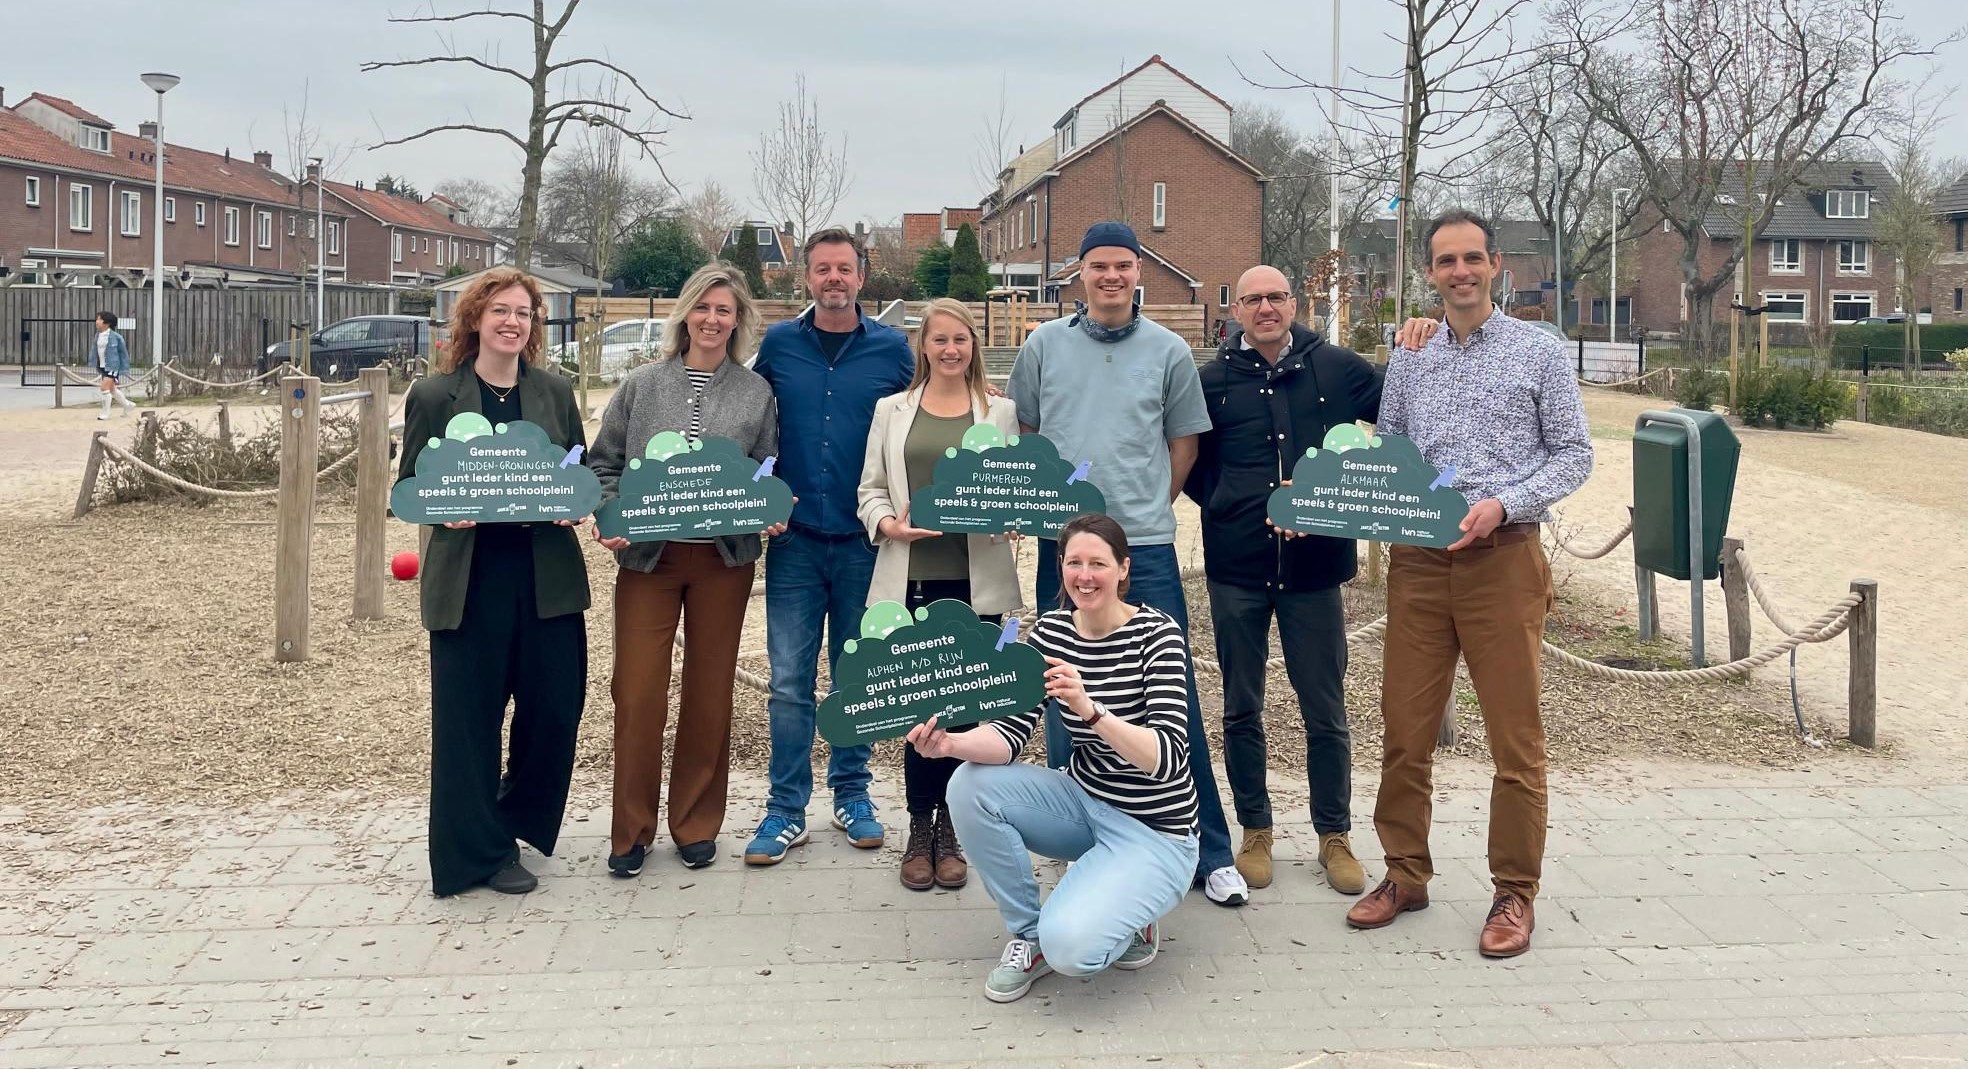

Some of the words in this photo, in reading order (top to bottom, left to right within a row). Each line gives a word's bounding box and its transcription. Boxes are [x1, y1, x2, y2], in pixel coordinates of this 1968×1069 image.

[469, 447, 527, 457] Gemeente
[457, 460, 555, 472] MIDDEN-GRONINGEN
[667, 463, 722, 475] Gemeente
[982, 458, 1037, 470] Gemeente
[1342, 460, 1398, 473] Gemeente
[441, 473, 470, 484] gunt
[472, 473, 501, 483] ieder
[504, 472, 529, 483] kind
[532, 474, 553, 482] een
[972, 472, 1032, 485] PURMEREND
[1340, 473, 1388, 488] ALKMAAR
[418, 487, 457, 498] speels
[459, 487, 467, 497] &
[469, 488, 504, 498] groen
[506, 485, 574, 497] schoolplein!
[660, 478, 713, 492] ENSCHEDE
[955, 485, 981, 496] gunt
[983, 485, 1011, 496] ieder
[1013, 486, 1036, 497] kind
[1039, 489, 1059, 498] een
[642, 491, 668, 504] gunt
[670, 491, 698, 501] ieder
[700, 488, 724, 498] kind
[726, 487, 746, 496] een
[1313, 485, 1339, 497] gunt
[1341, 488, 1370, 499] ieder
[1371, 490, 1396, 501] kind
[1398, 494, 1420, 504] een
[621, 507, 656, 518] speels
[658, 505, 666, 515] &
[668, 504, 700, 515] groen
[702, 498, 767, 512] schoolplein!
[934, 498, 969, 508] speels
[970, 498, 978, 507] &
[980, 500, 1012, 510] groen
[1014, 500, 1079, 513] schoolplein!
[1291, 497, 1326, 509] speels
[1327, 500, 1335, 509] &
[1337, 502, 1369, 513] groen
[1371, 505, 1441, 520] schoolplein!
[1401, 527, 1416, 537] ivn
[890, 635, 956, 655] Gemeente
[866, 662, 904, 679] ALPHEN
[911, 657, 931, 670] A/D
[938, 650, 964, 666] RIJN
[866, 680, 897, 696] gunt
[899, 672, 932, 687] ieder
[934, 665, 963, 681] kind
[965, 661, 990, 673] een
[844, 698, 886, 715] speels
[887, 694, 896, 706] &
[899, 689, 937, 706] groen
[939, 671, 1017, 699] schoolplein!
[979, 701, 996, 710] ivn
